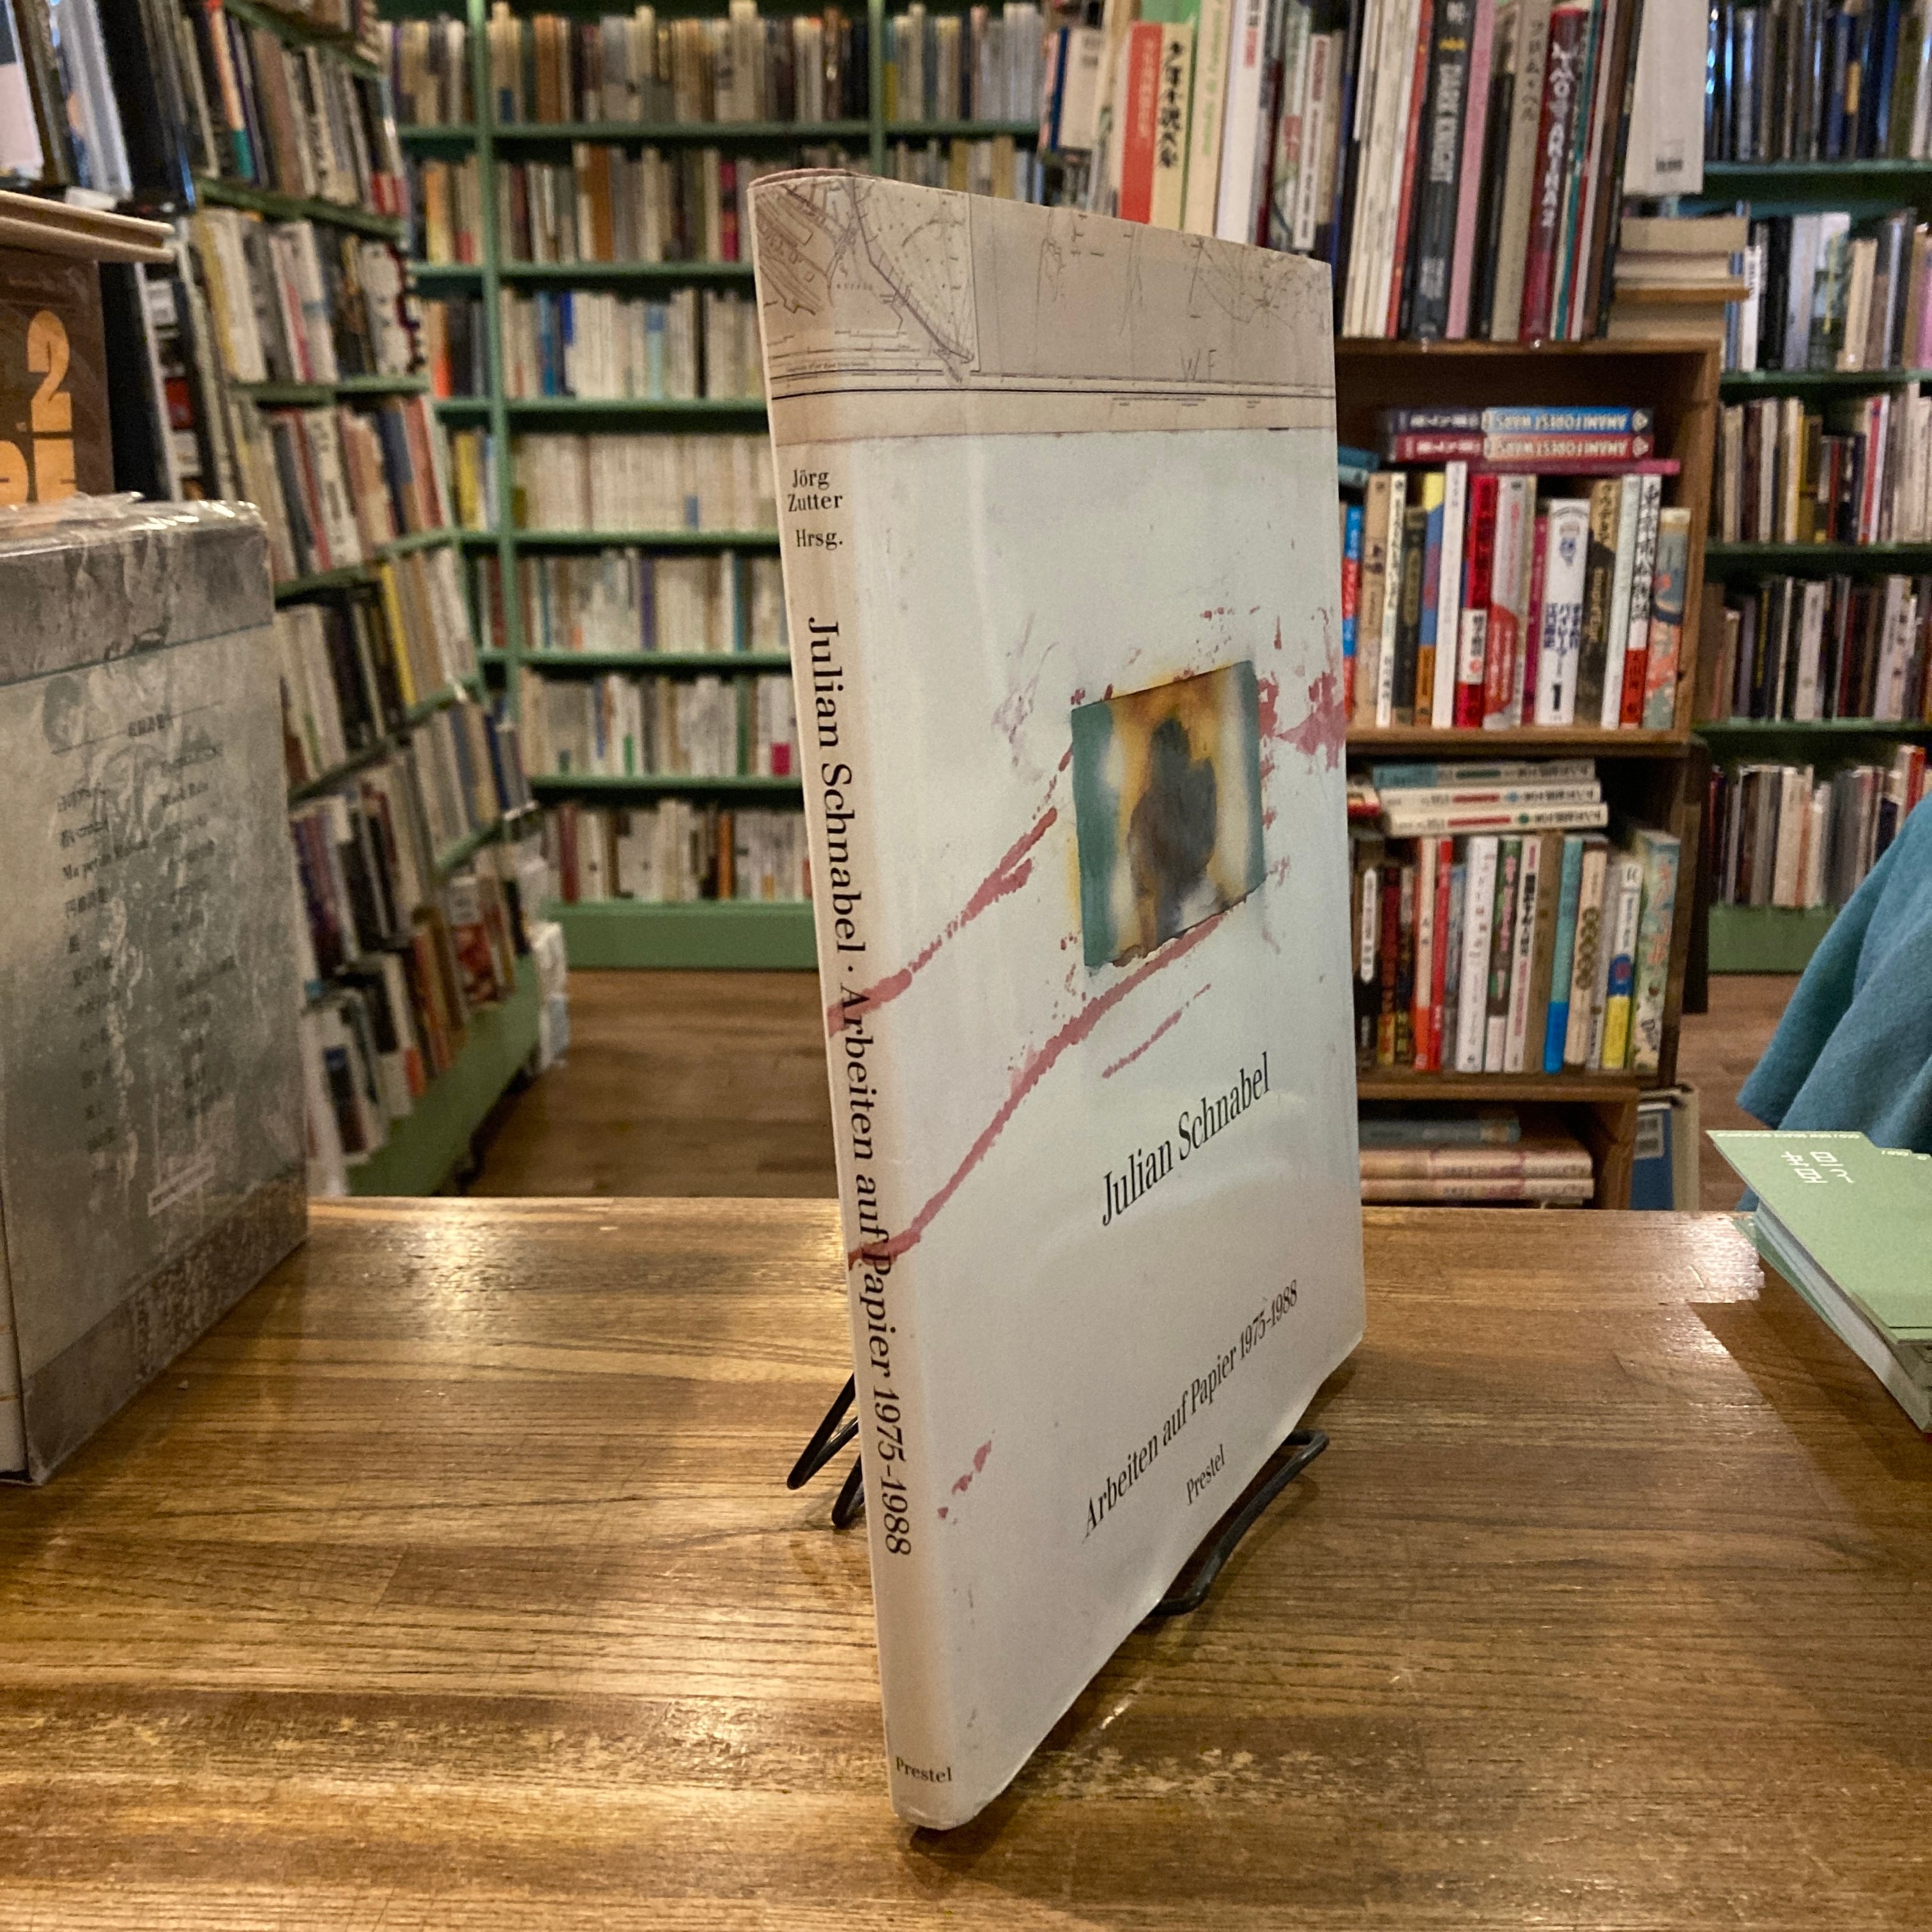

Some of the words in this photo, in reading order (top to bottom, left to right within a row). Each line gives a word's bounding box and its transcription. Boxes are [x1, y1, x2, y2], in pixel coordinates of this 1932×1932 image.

[788, 493, 843, 512] Zutter
[792, 469, 830, 491] Jörg
[796, 528, 843, 551] Hrsg.
[808, 617, 844, 750] Julian
[821, 762, 866, 954] Schnabel
[840, 982, 878, 1162] Arbeiten
[1102, 1139, 1174, 1227] Julian
[1178, 1050, 1270, 1161] Schnabel
[855, 1173, 890, 1244] auf
[860, 1254, 896, 1379] Papier
[873, 1384, 912, 1556] 1975-1988
[1083, 1435, 1158, 1544] Arbeiten
[1162, 1390, 1189, 1447] auf
[1190, 1346, 1237, 1416] Papier
[1239, 1278, 1298, 1361] 1975-1988
[1186, 1443, 1225, 1506] Prestel
[896, 1756, 953, 1784] Prestel
